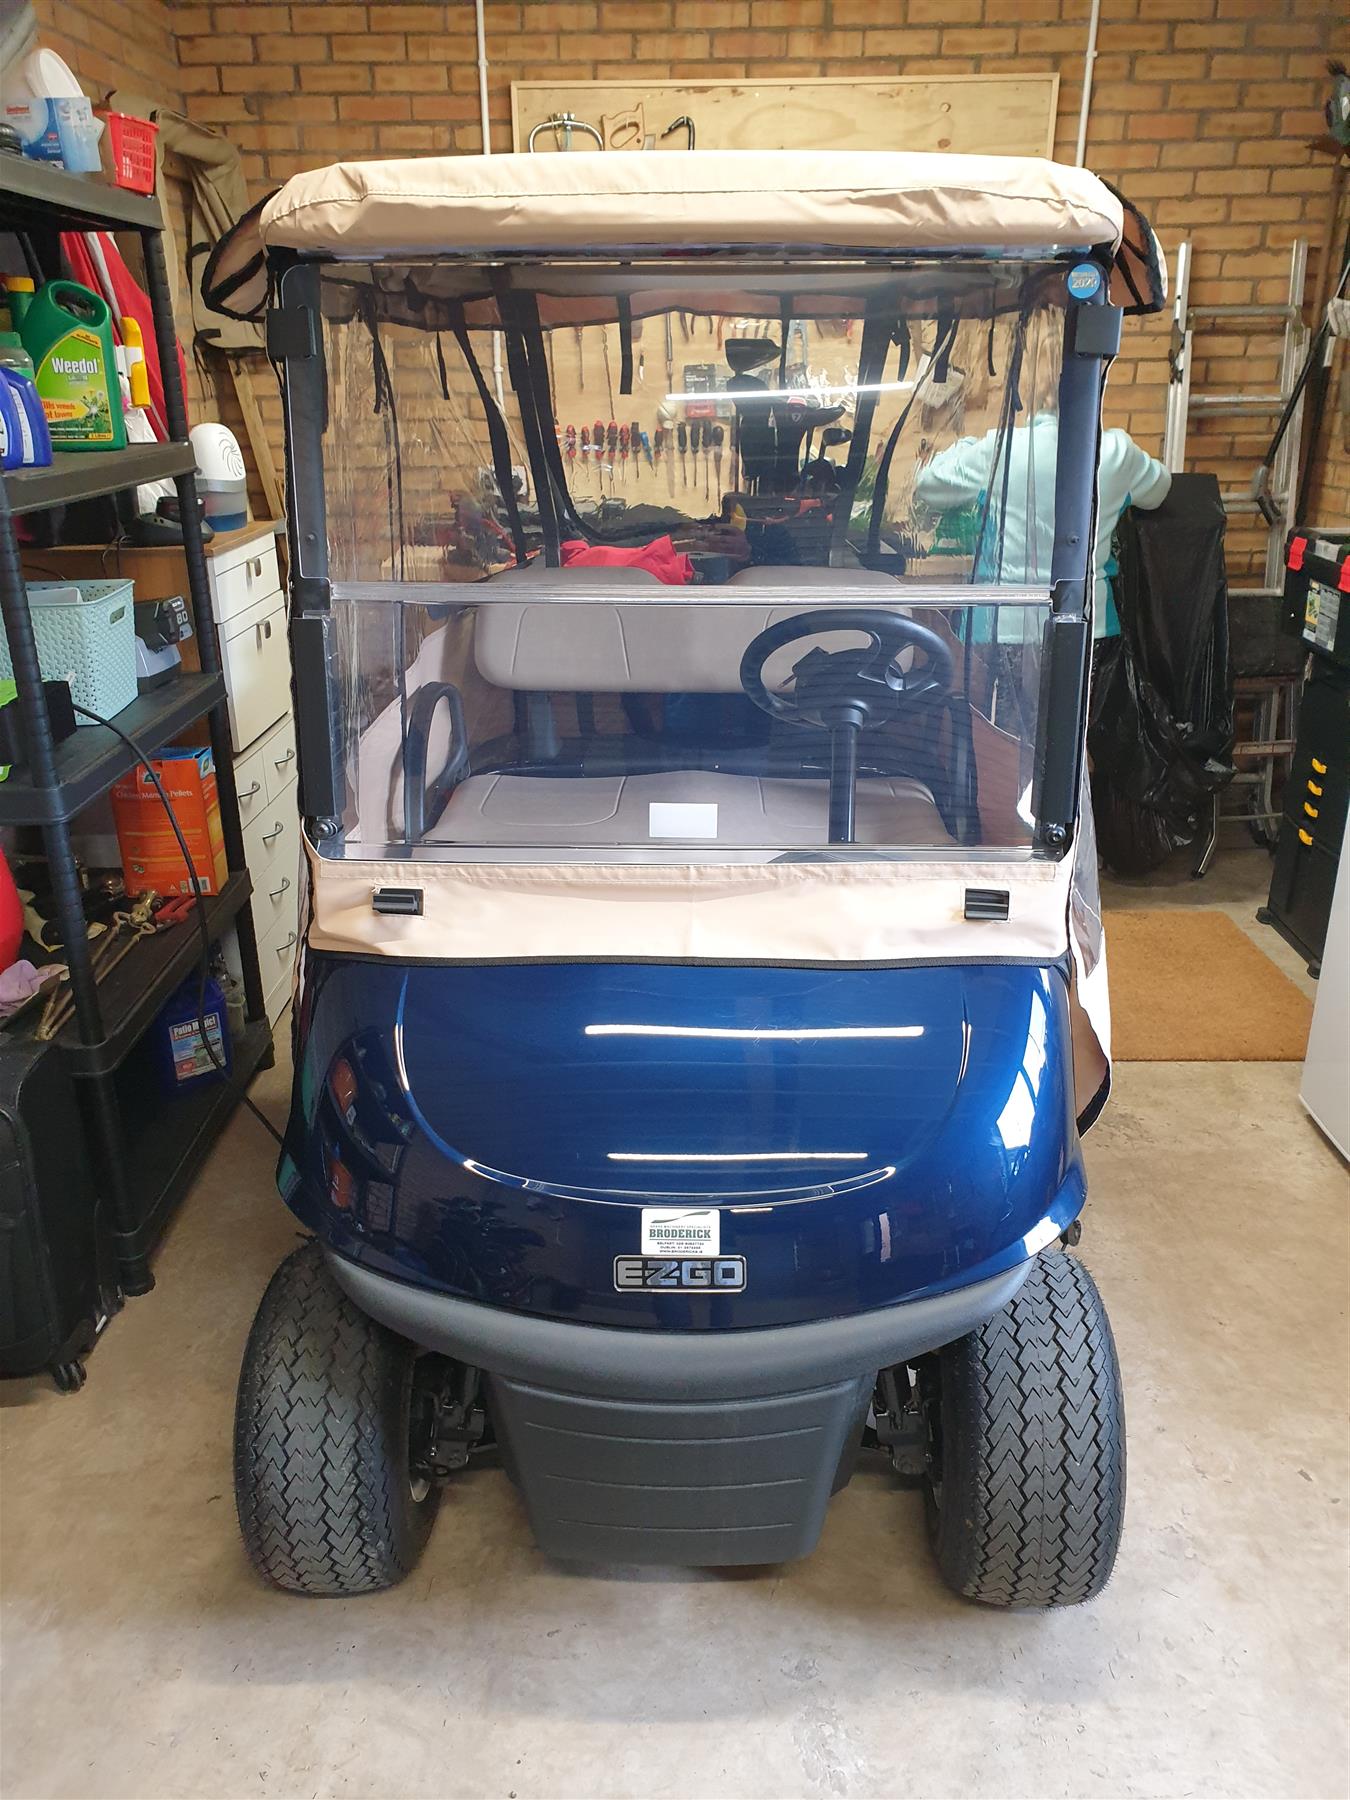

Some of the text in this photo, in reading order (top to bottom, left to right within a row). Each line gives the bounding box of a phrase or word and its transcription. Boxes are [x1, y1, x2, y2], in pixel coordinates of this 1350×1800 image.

[51, 357, 98, 374] Weedol
[176, 610, 188, 625] 80
[170, 790, 193, 798] Pellets
[173, 1024, 192, 1036] Patio
[649, 1229, 711, 1238] BRODERICK
